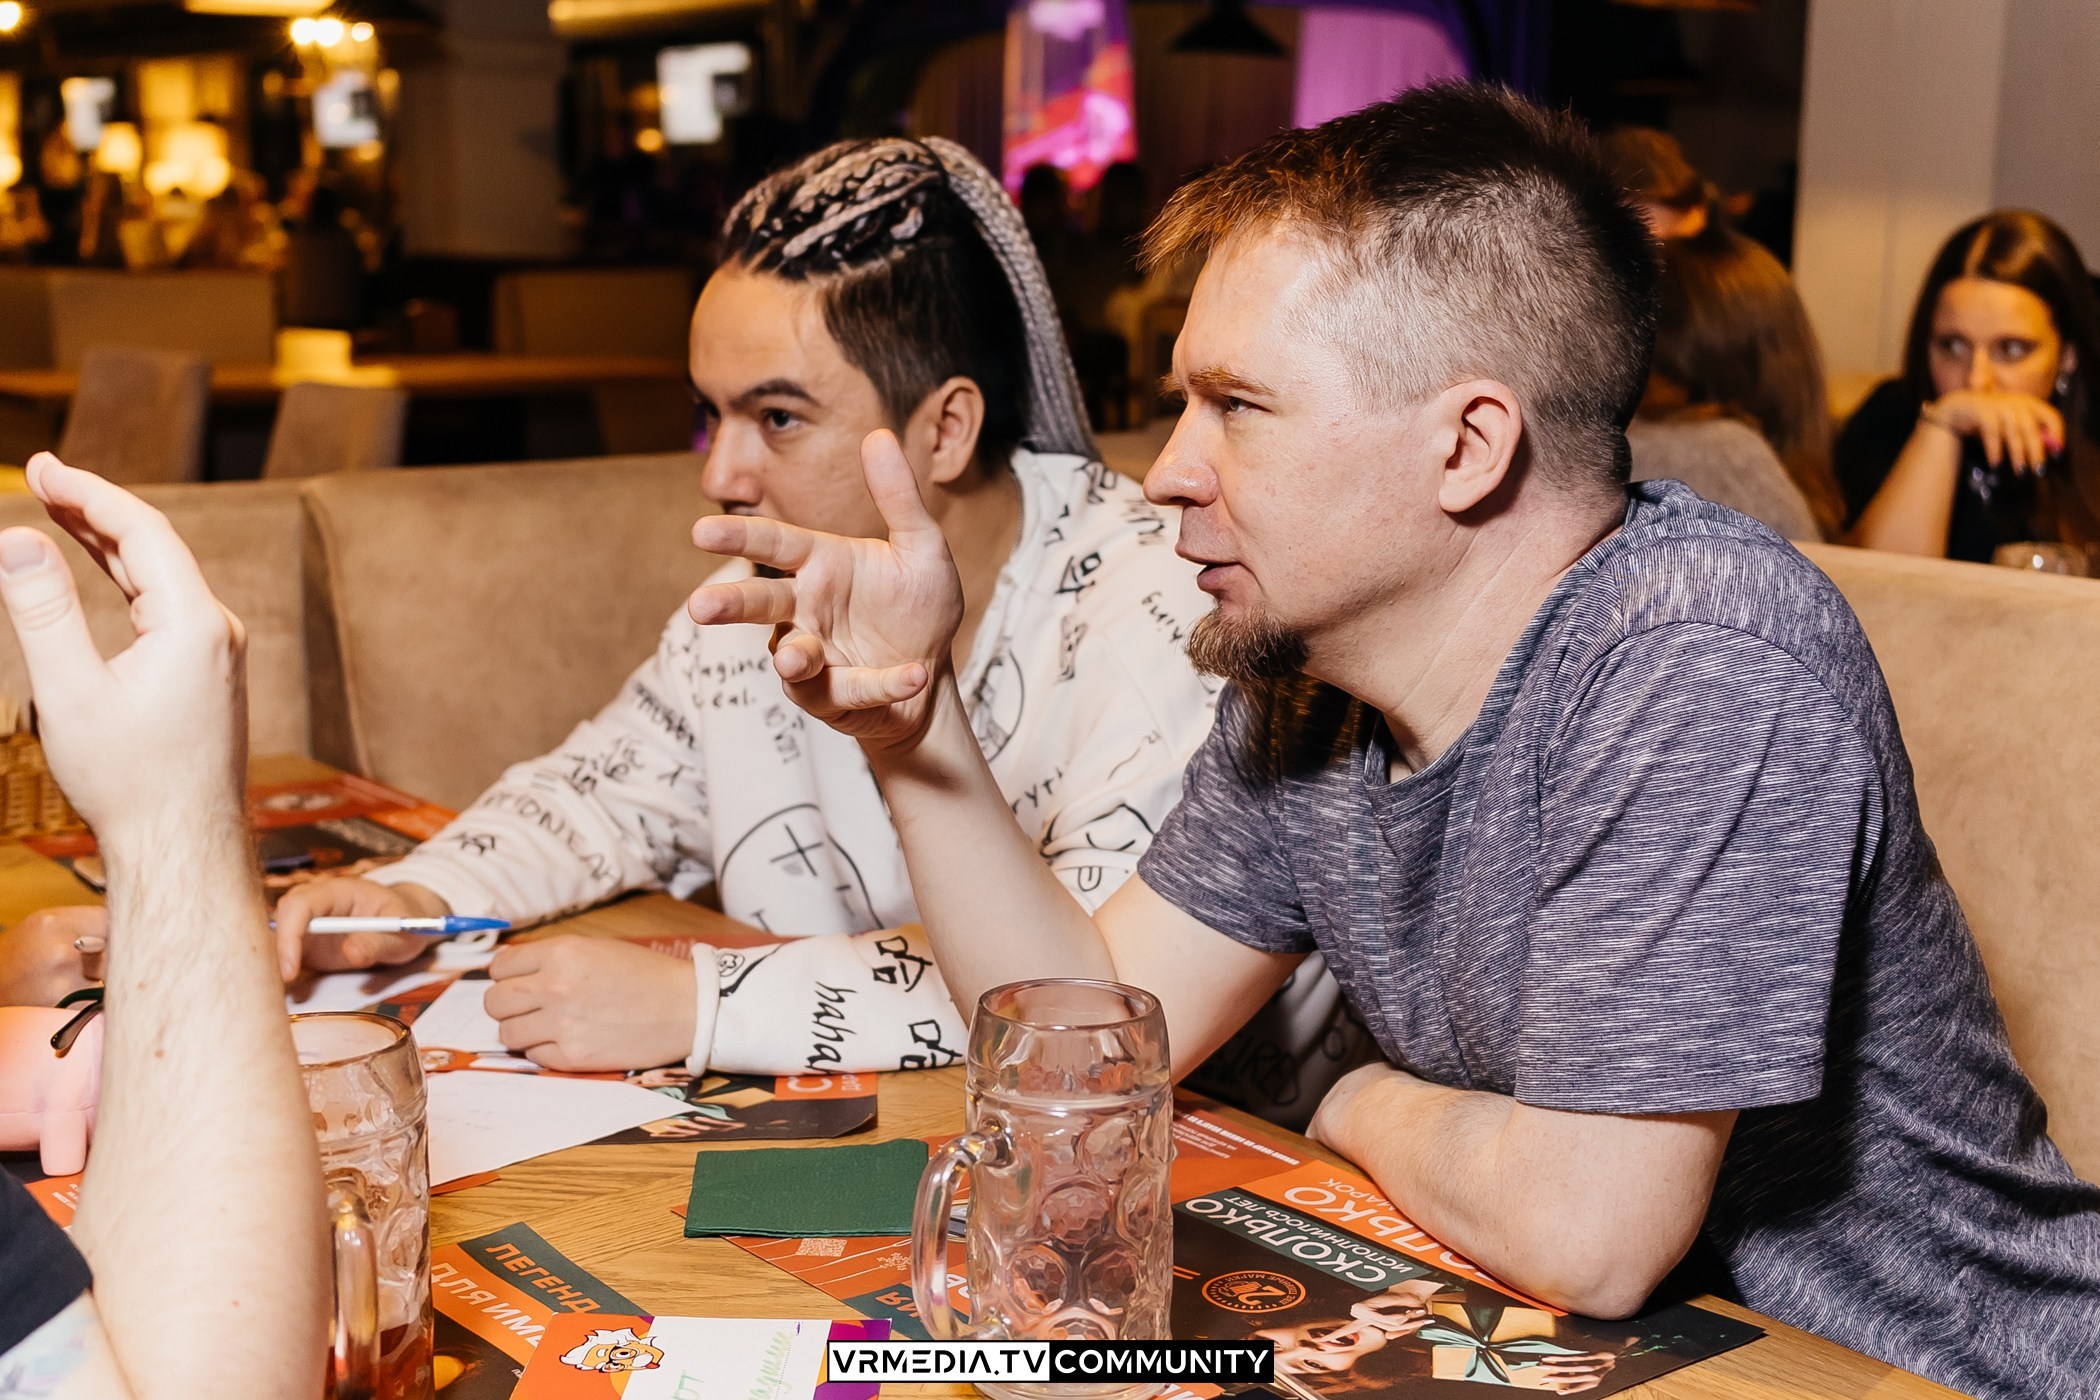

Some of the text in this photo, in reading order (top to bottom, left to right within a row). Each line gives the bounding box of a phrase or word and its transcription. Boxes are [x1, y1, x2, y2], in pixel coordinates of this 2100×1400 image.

[1185, 1198, 1387, 1283] СКОЛЬКО
[1223, 1196, 1414, 1274] ИСПОЛНИЛОСЬ ЛЕТ
[431, 1262, 498, 1306] ДЛЯ
[485, 1243, 601, 1314] ЛЕГЕНД
